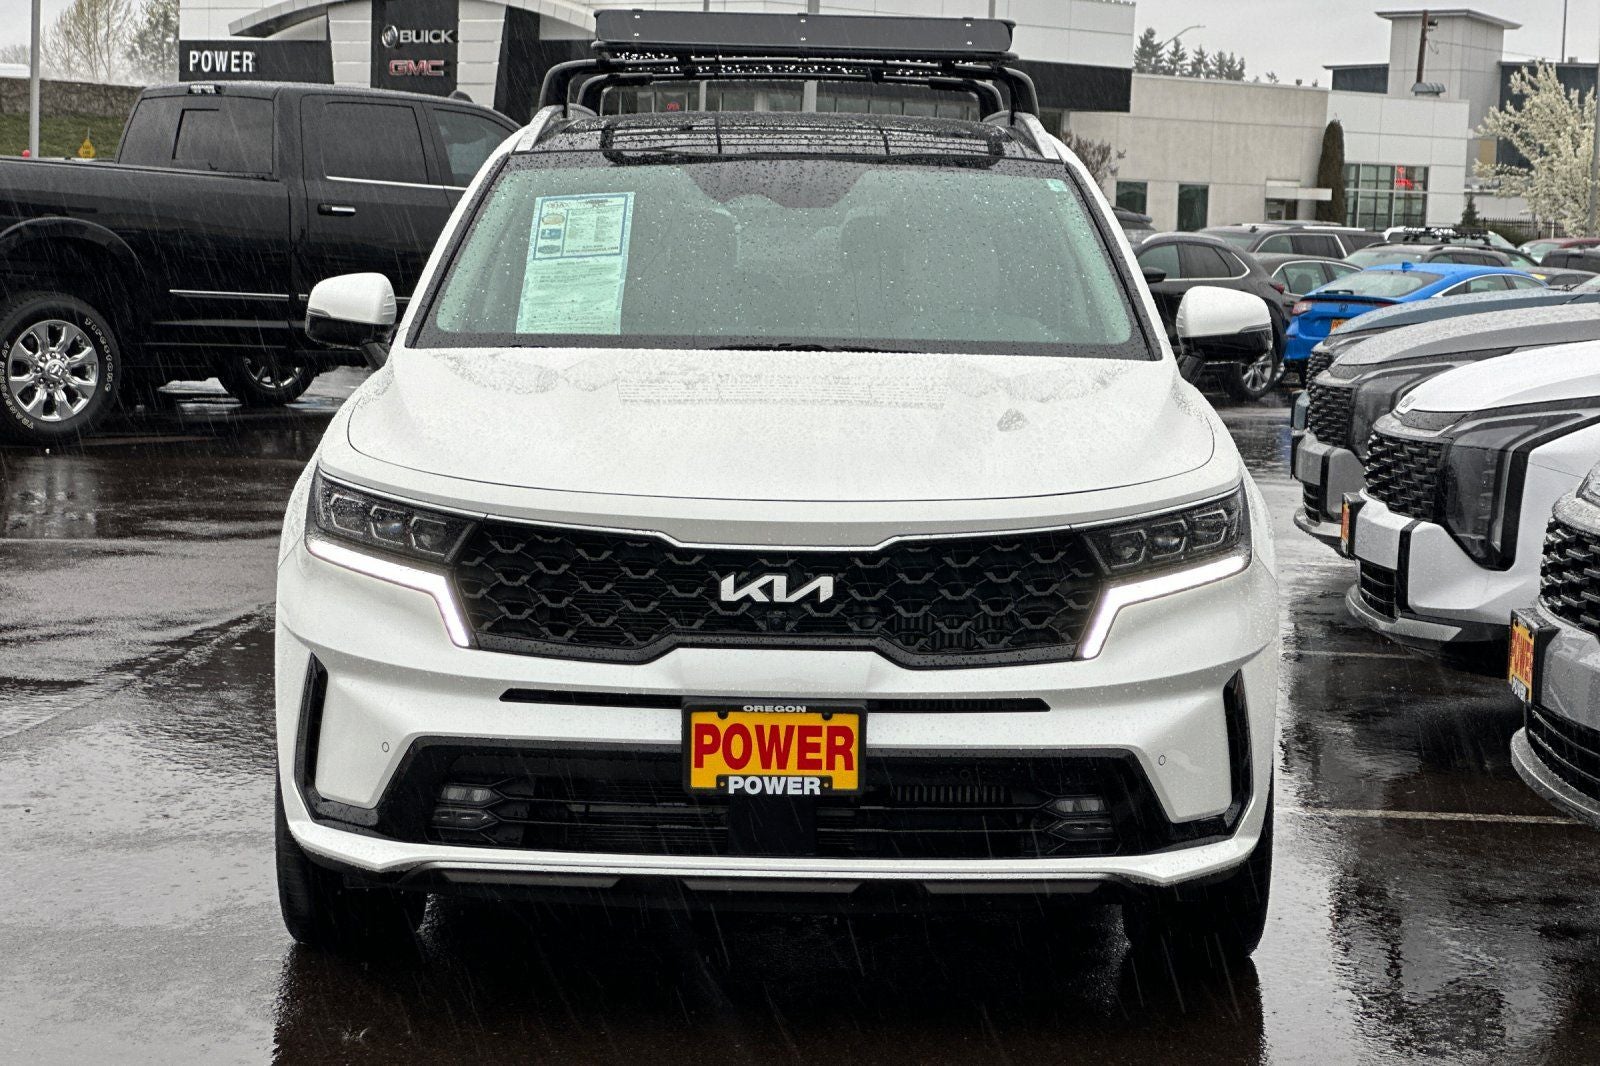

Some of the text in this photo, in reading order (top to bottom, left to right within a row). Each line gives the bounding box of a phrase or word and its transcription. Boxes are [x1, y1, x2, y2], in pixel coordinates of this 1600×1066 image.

[399, 29, 454, 44] BUICK
[189, 50, 255, 73] POWER
[388, 59, 445, 76] GMC
[720, 574, 834, 603] KIA
[742, 704, 807, 713] OREGON
[693, 722, 855, 771] POWER
[728, 776, 821, 795] POWER
